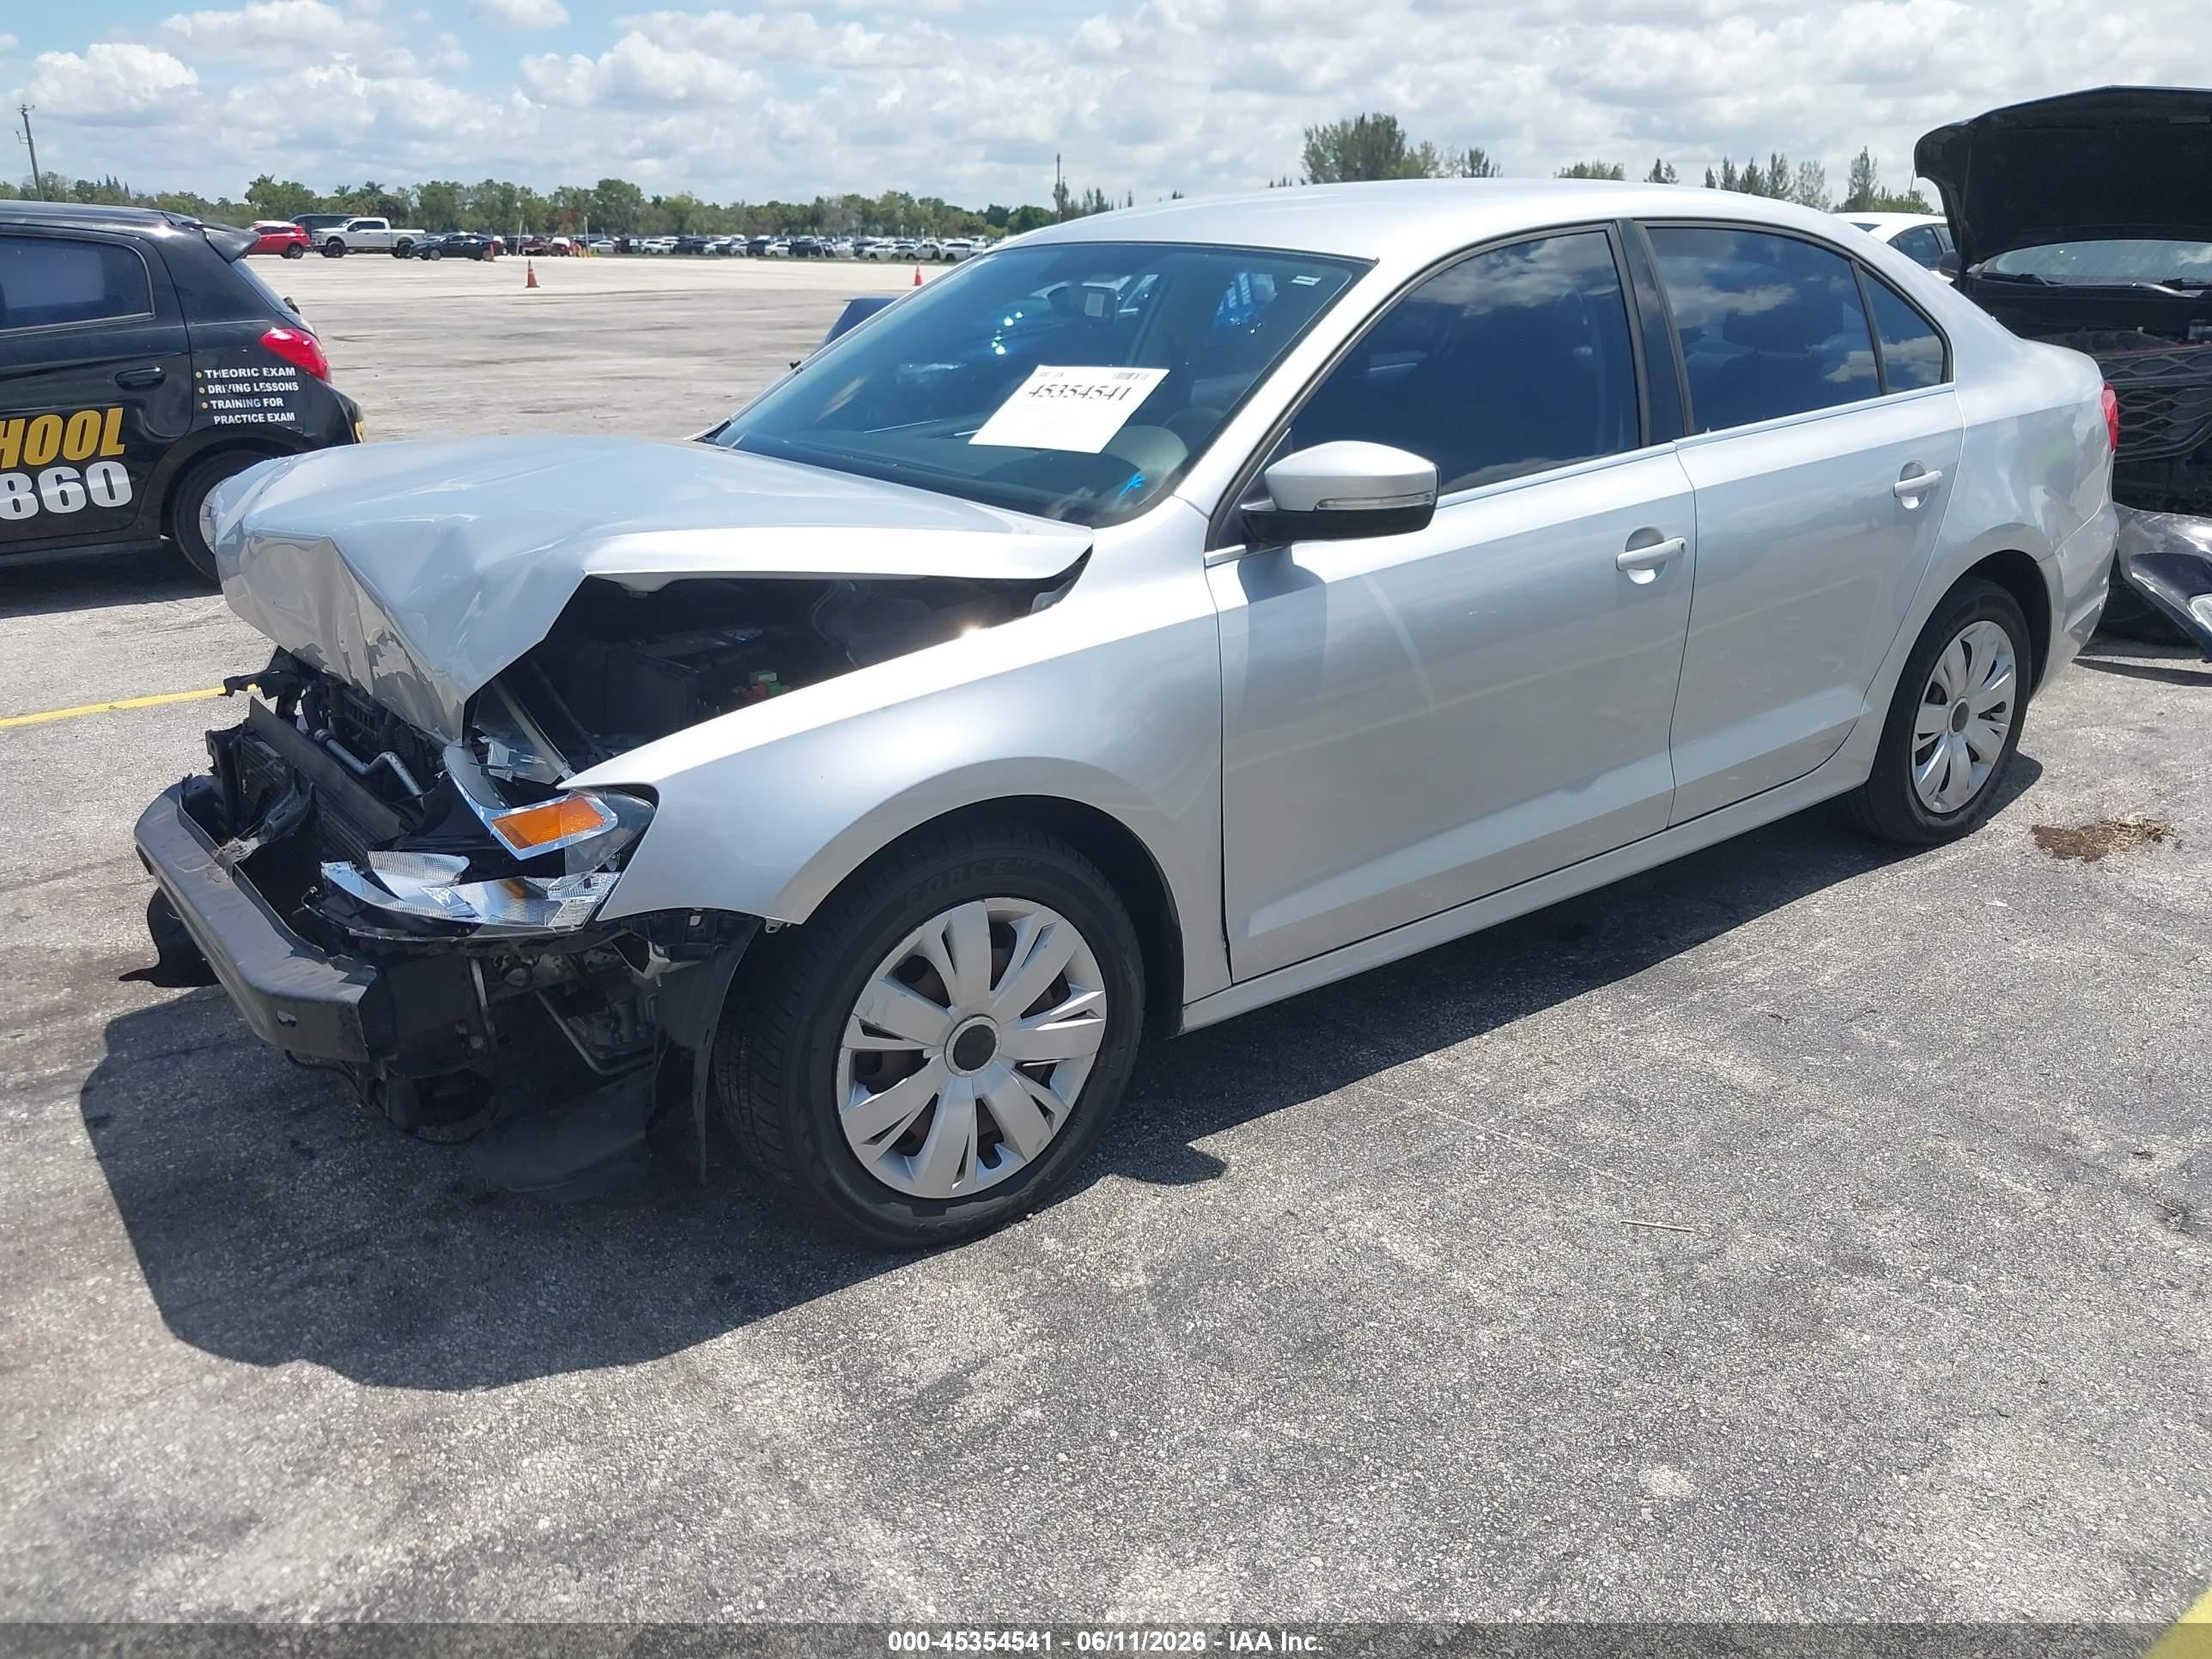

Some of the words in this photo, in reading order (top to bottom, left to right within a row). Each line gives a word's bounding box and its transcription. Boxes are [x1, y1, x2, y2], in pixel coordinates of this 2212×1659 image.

[204, 368, 260, 379] THEORIC
[262, 367, 296, 377] EXAM
[207, 383, 252, 394] DRIVING
[253, 381, 300, 392] LESSONS
[1029, 384, 1133, 401] 45354541
[210, 398, 261, 410] TRAINING
[263, 398, 284, 407] FOR
[214, 413, 265, 425] PRACTICE
[267, 412, 296, 422] EXAM
[0, 460, 133, 520] 860
